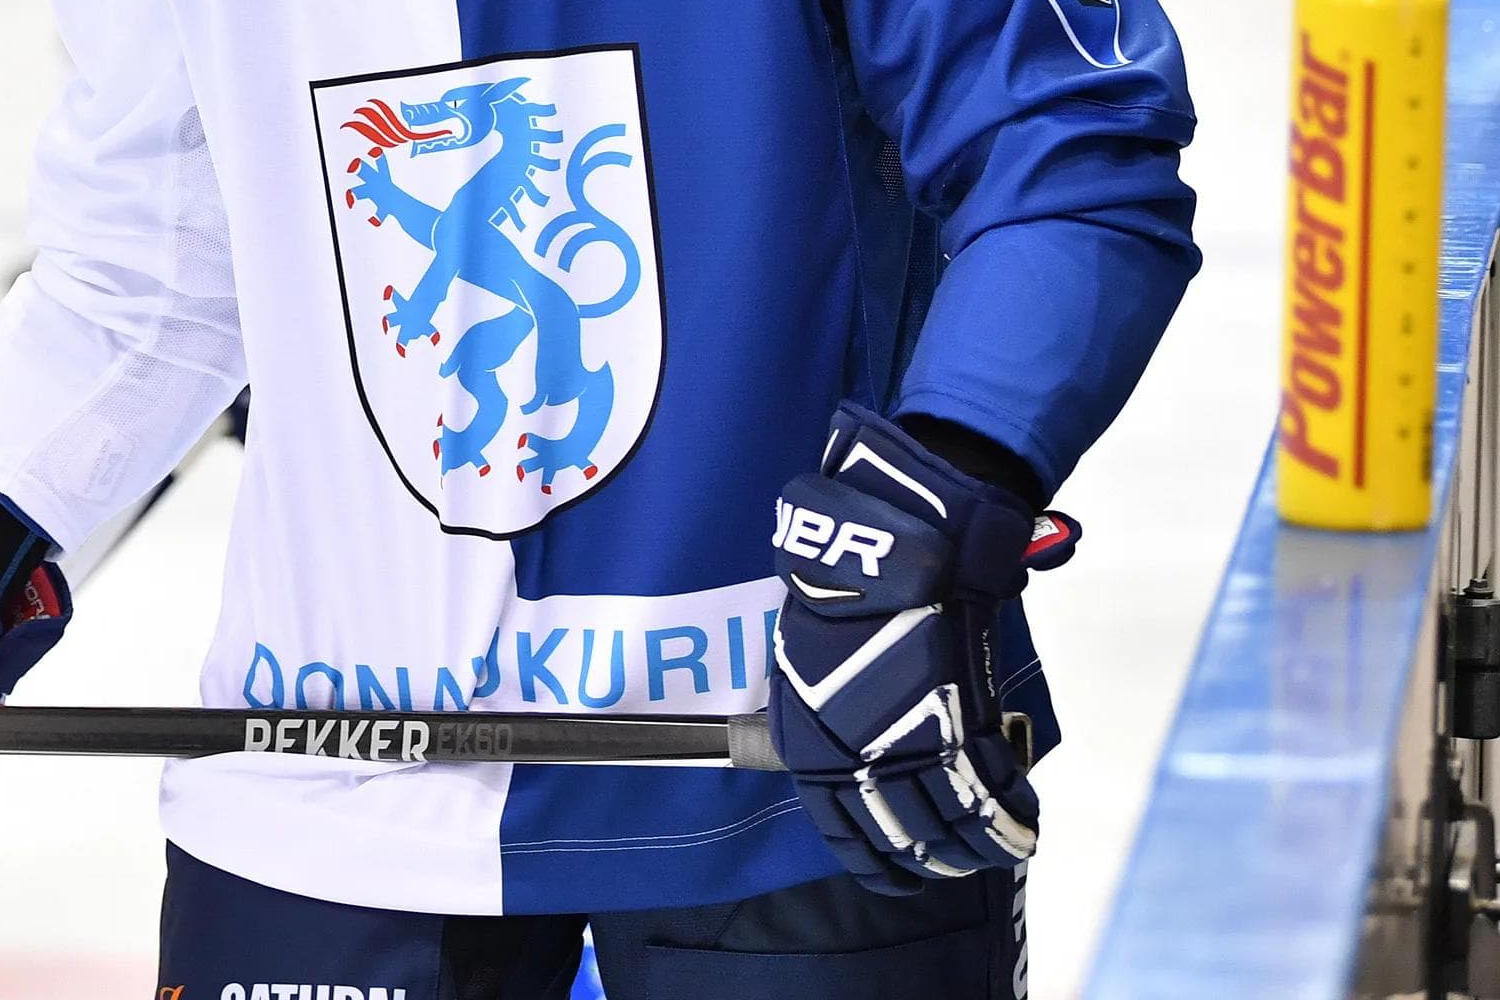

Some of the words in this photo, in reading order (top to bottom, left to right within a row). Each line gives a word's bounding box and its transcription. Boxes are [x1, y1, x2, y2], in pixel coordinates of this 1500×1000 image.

[1279, 32, 1350, 480] PowerBar
[243, 608, 779, 712] DONAUKURI
[244, 718, 430, 762] REKKER
